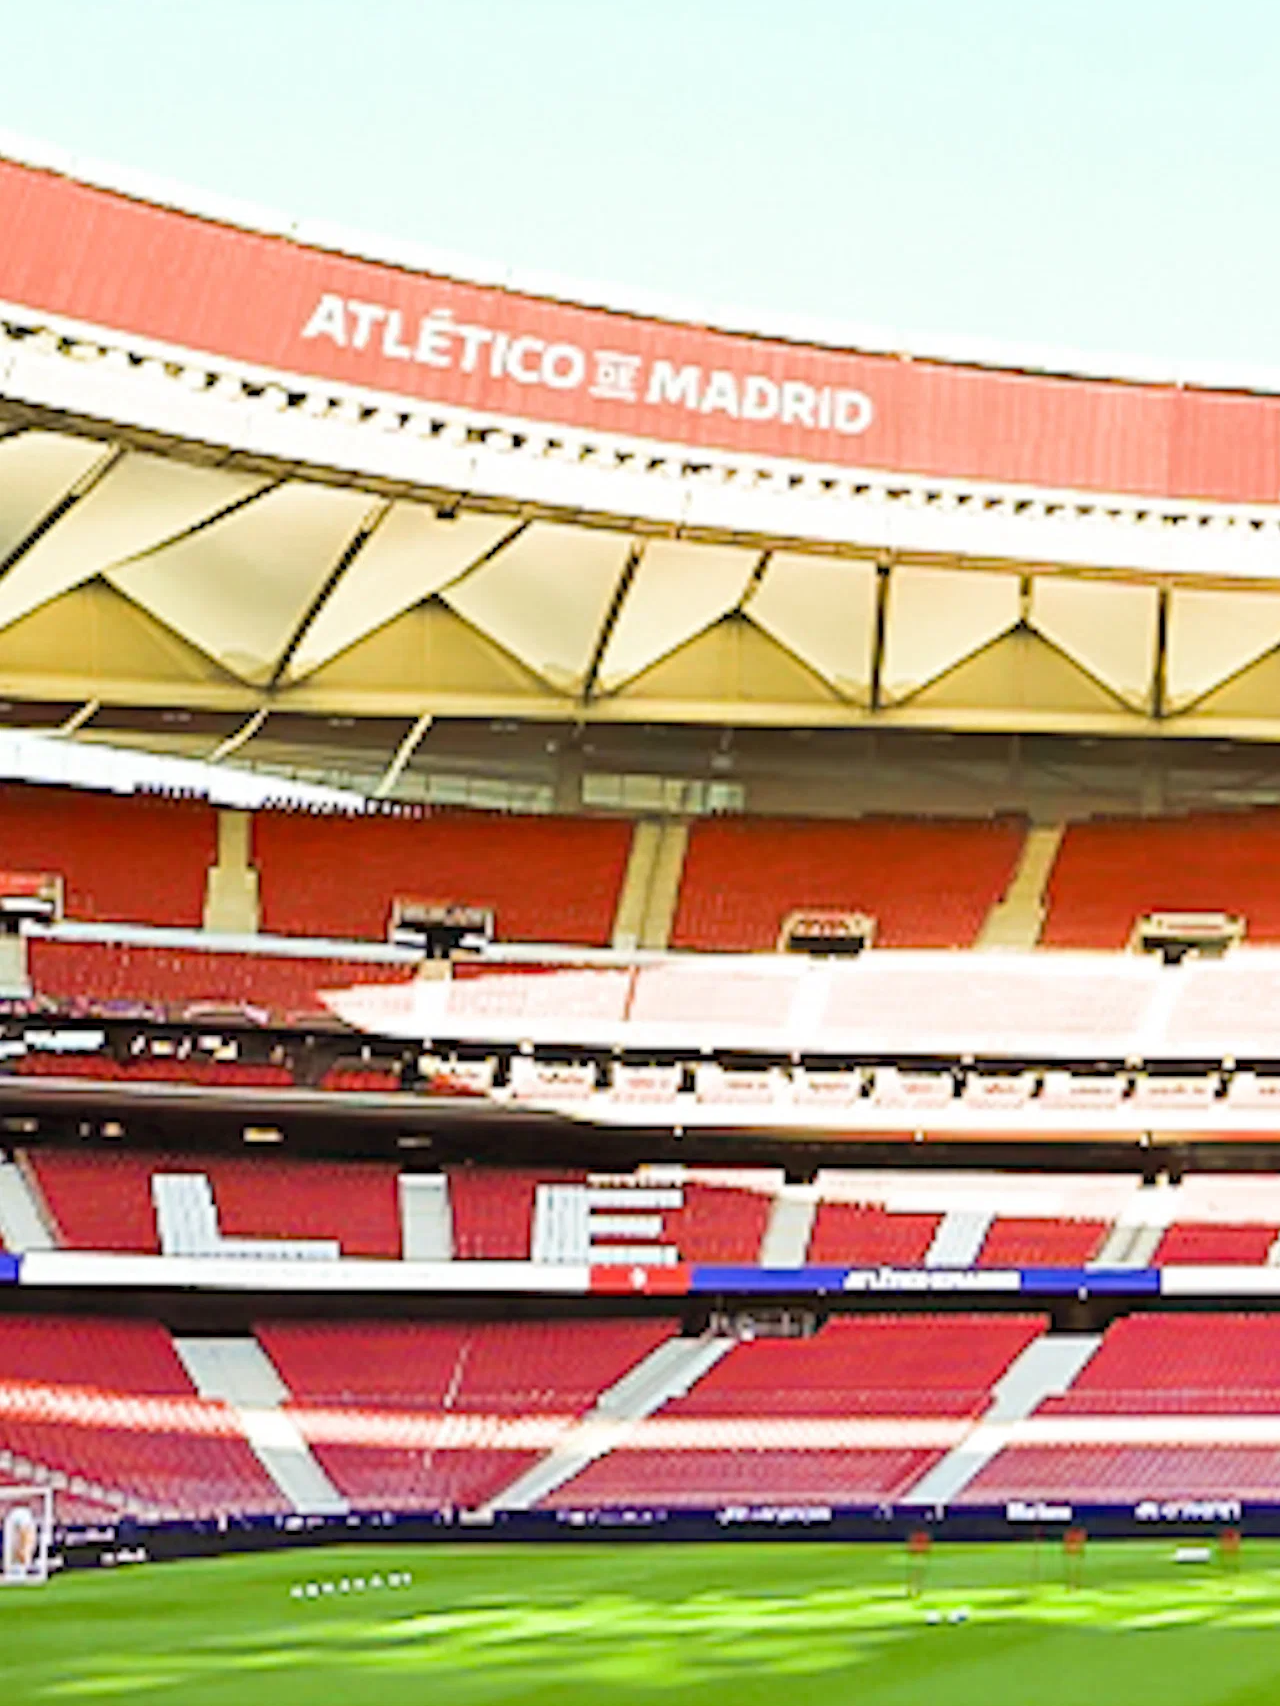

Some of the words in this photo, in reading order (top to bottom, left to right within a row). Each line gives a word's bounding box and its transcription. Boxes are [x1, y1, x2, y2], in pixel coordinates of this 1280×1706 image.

[301, 294, 584, 390] ATLÉTICO
[591, 353, 641, 400] DE
[645, 360, 872, 435] MADRID
